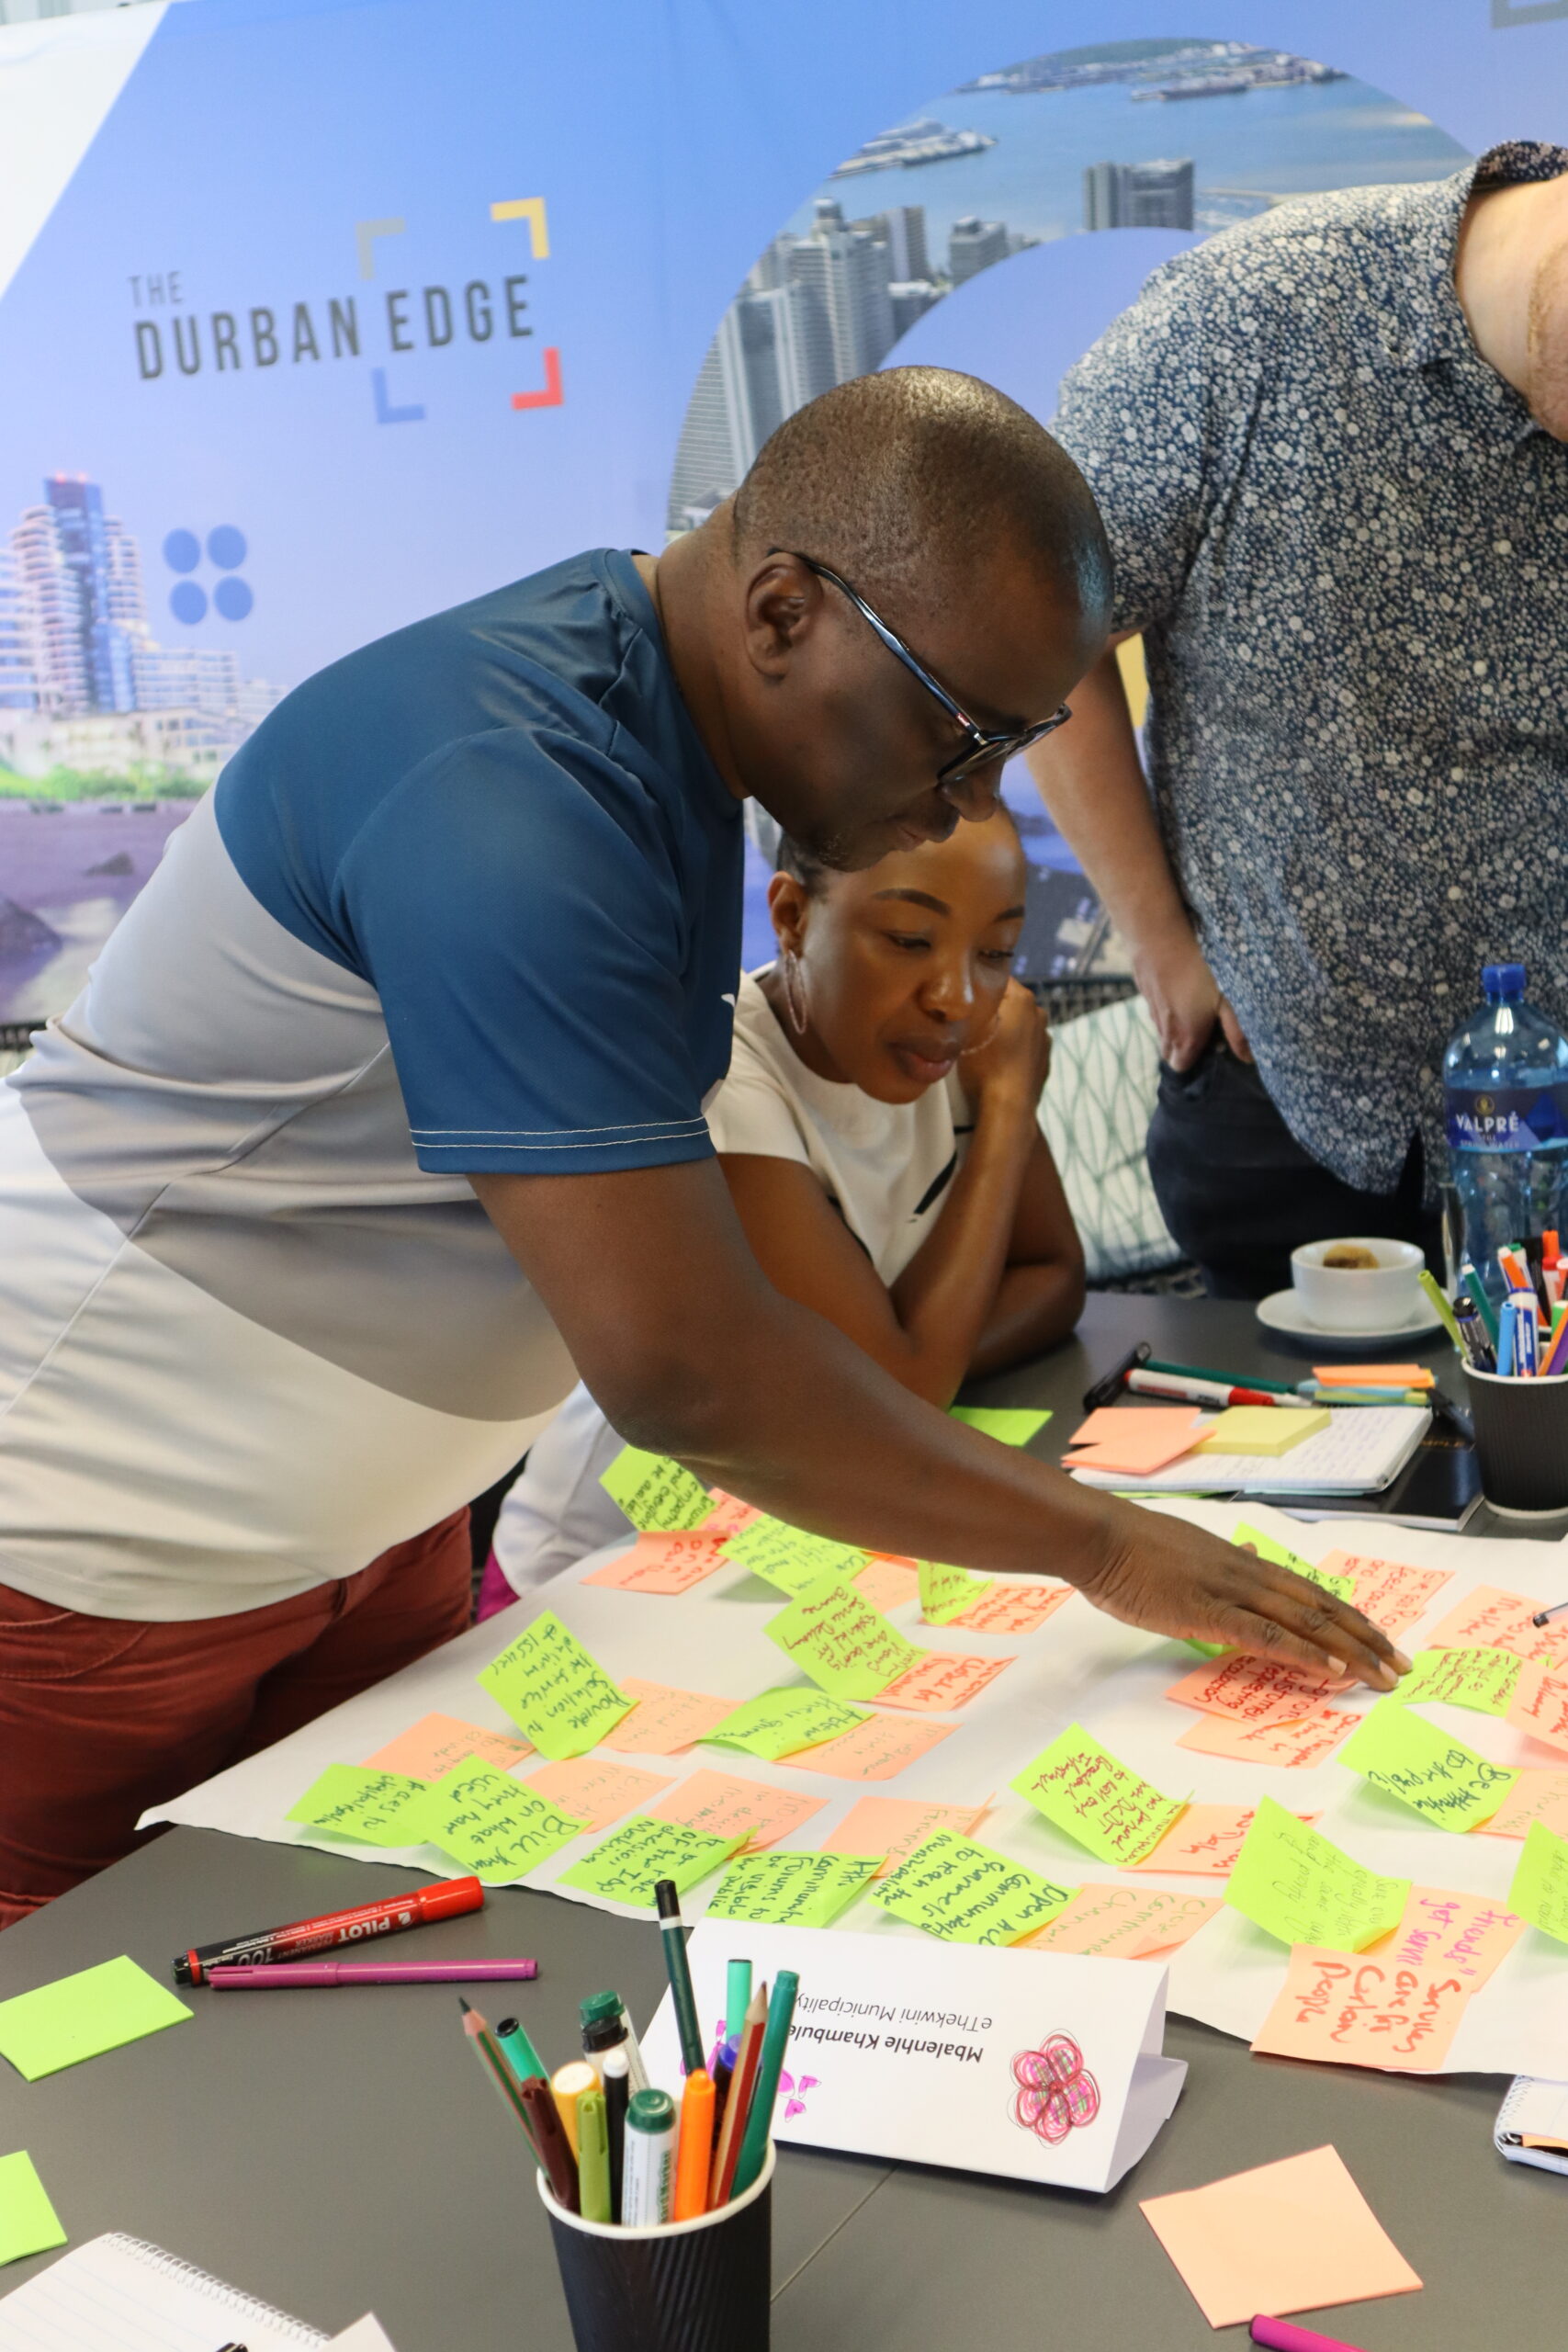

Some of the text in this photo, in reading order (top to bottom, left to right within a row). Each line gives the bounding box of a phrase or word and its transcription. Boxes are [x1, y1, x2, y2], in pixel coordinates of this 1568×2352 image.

[128, 272, 184, 308] THE
[134, 275, 535, 381] DURBAN EDGE
[1455, 1111, 1519, 1133] VALPRÉ
[567, 1688, 631, 1729] Provide
[1099, 1796, 1139, 1835] DCDT
[955, 1847, 984, 1861] to
[1015, 1883, 1068, 1918] Open
[1419, 1898, 1461, 1928] get
[338, 1917, 390, 1943] PILOT
[1387, 1970, 1418, 2008] are
[796, 1993, 992, 2031] eThekwini Municipality
[789, 2024, 983, 2063] Mbalenhle Khambule
